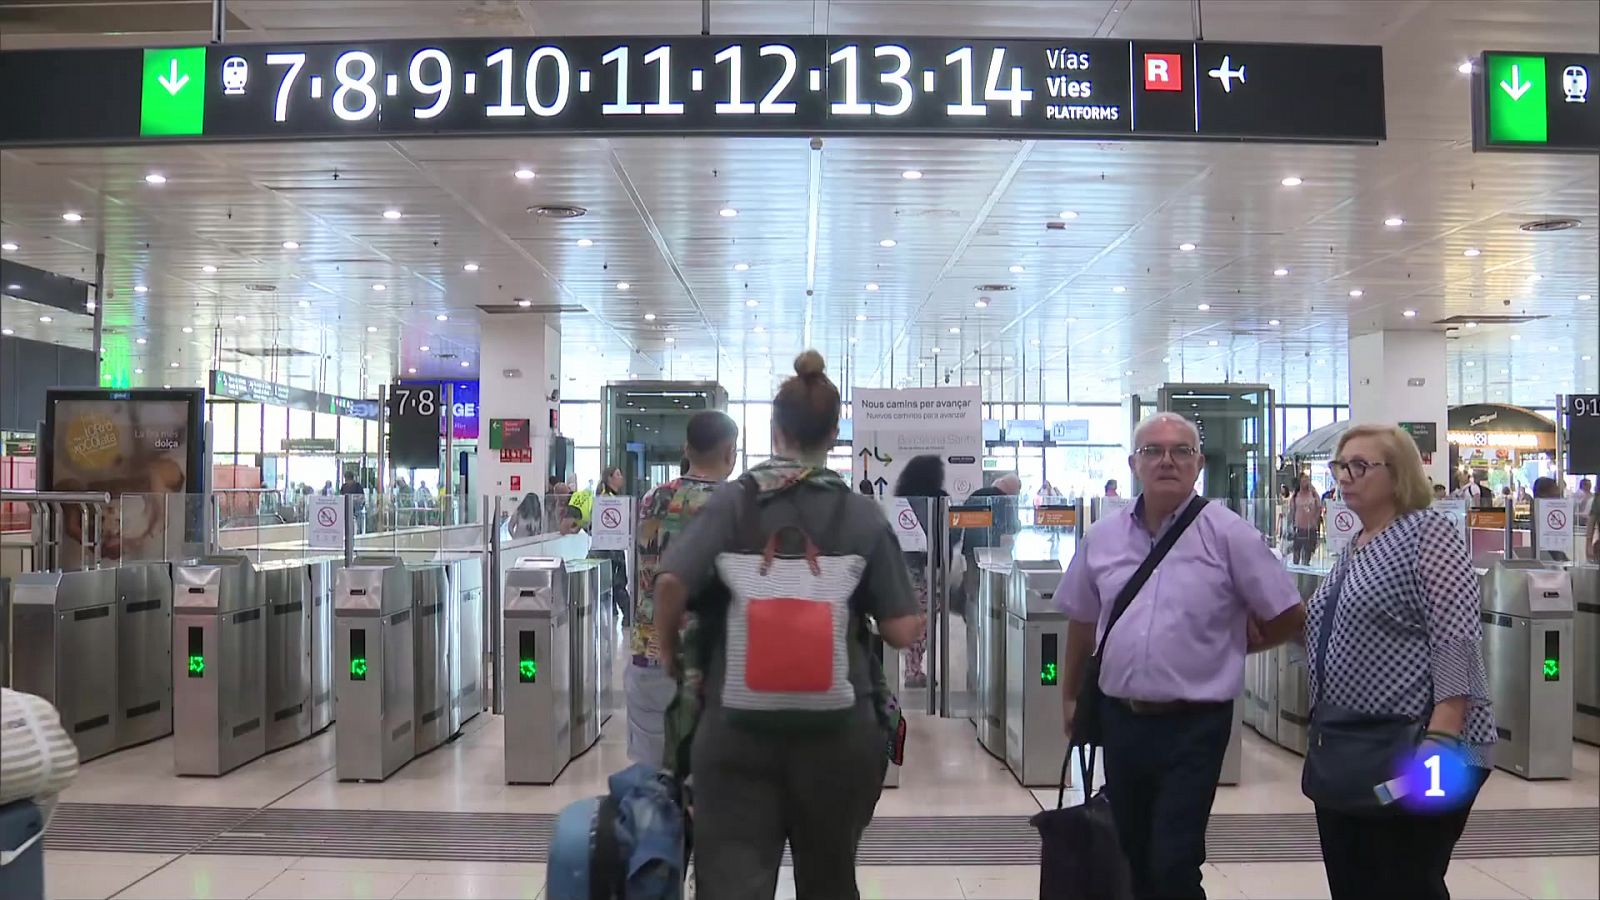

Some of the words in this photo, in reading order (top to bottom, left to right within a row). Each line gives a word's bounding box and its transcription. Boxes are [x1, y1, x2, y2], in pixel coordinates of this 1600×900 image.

[1046, 47, 1090, 70] Vías
[1147, 59, 1169, 82] R
[1046, 75, 1092, 98] Vies
[1046, 105, 1119, 121] PLATFORMS
[861, 399, 885, 409] Nous
[886, 399, 918, 409] camins
[920, 401, 935, 410] per
[936, 400, 972, 411] avançar
[866, 412, 892, 420] Nuevos
[893, 412, 922, 420] caminos
[923, 413, 939, 421] para
[940, 411, 966, 420] avanzar
[154, 437, 179, 449] dolça
